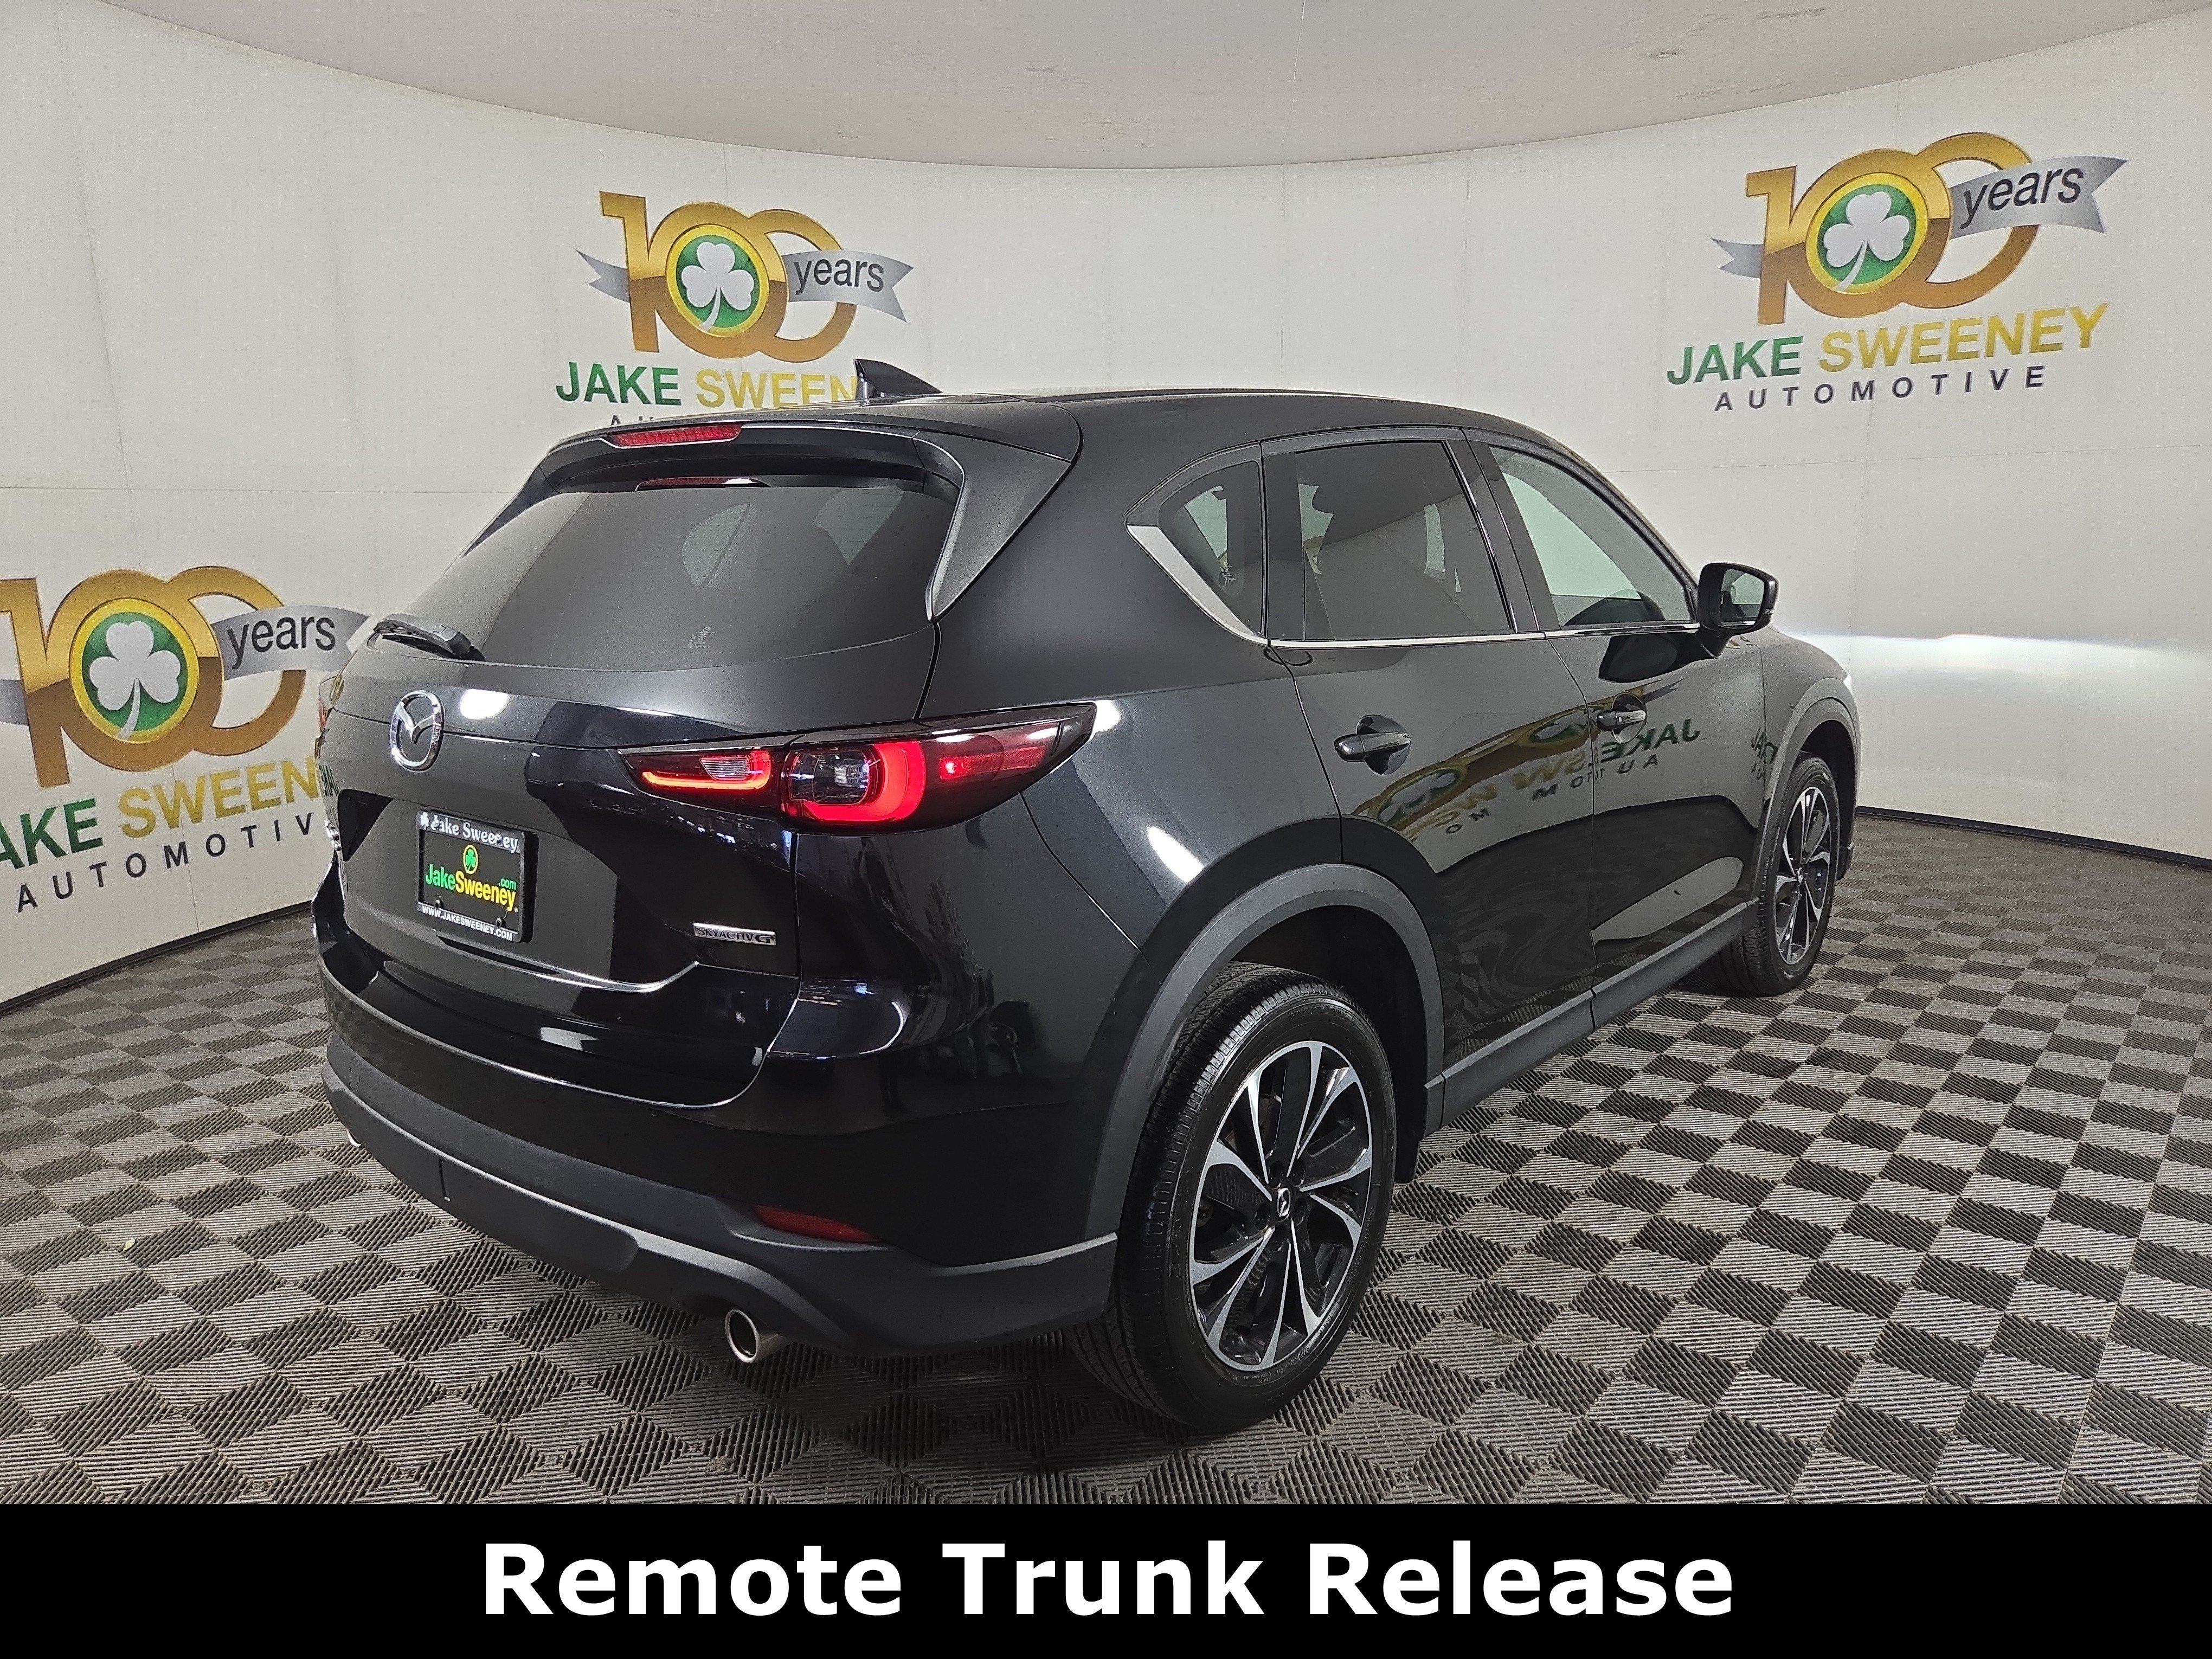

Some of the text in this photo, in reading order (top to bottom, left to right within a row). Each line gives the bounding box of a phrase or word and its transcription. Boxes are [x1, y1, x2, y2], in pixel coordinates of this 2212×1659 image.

[1746, 132, 2084, 325] 100 years
[600, 191, 885, 363] 100 years
[1667, 302, 2110, 385] JAKE SWEENEY
[556, 362, 682, 406] JAKE
[1714, 365, 2046, 412] AUTOMOTIVE
[227, 615, 336, 671] years
[421, 905, 513, 941] WWW.JAKESWEENEY.COM
